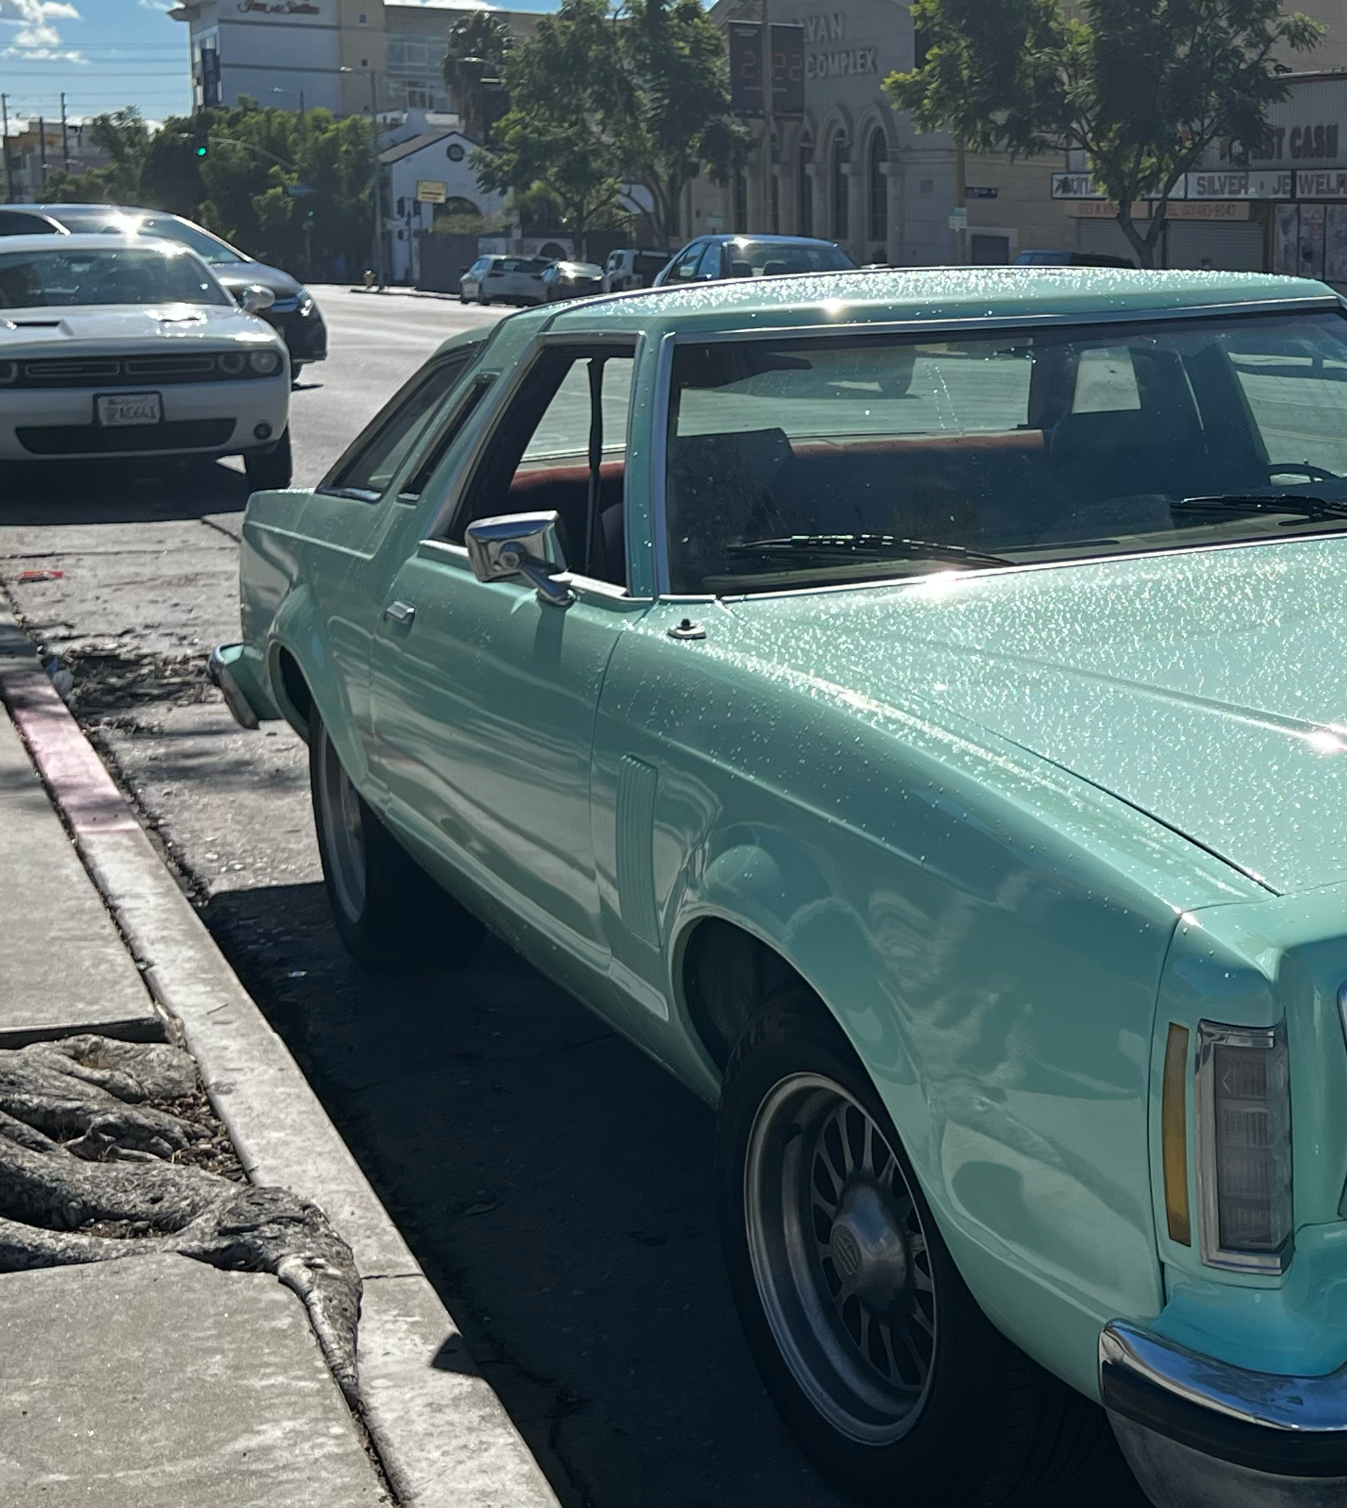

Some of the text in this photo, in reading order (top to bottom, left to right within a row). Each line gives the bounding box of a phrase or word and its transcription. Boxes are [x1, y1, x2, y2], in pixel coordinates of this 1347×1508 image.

[805, 47, 878, 79] COMPLEX
[1290, 125, 1338, 159] CASH
[1196, 175, 1249, 195] SILVER
